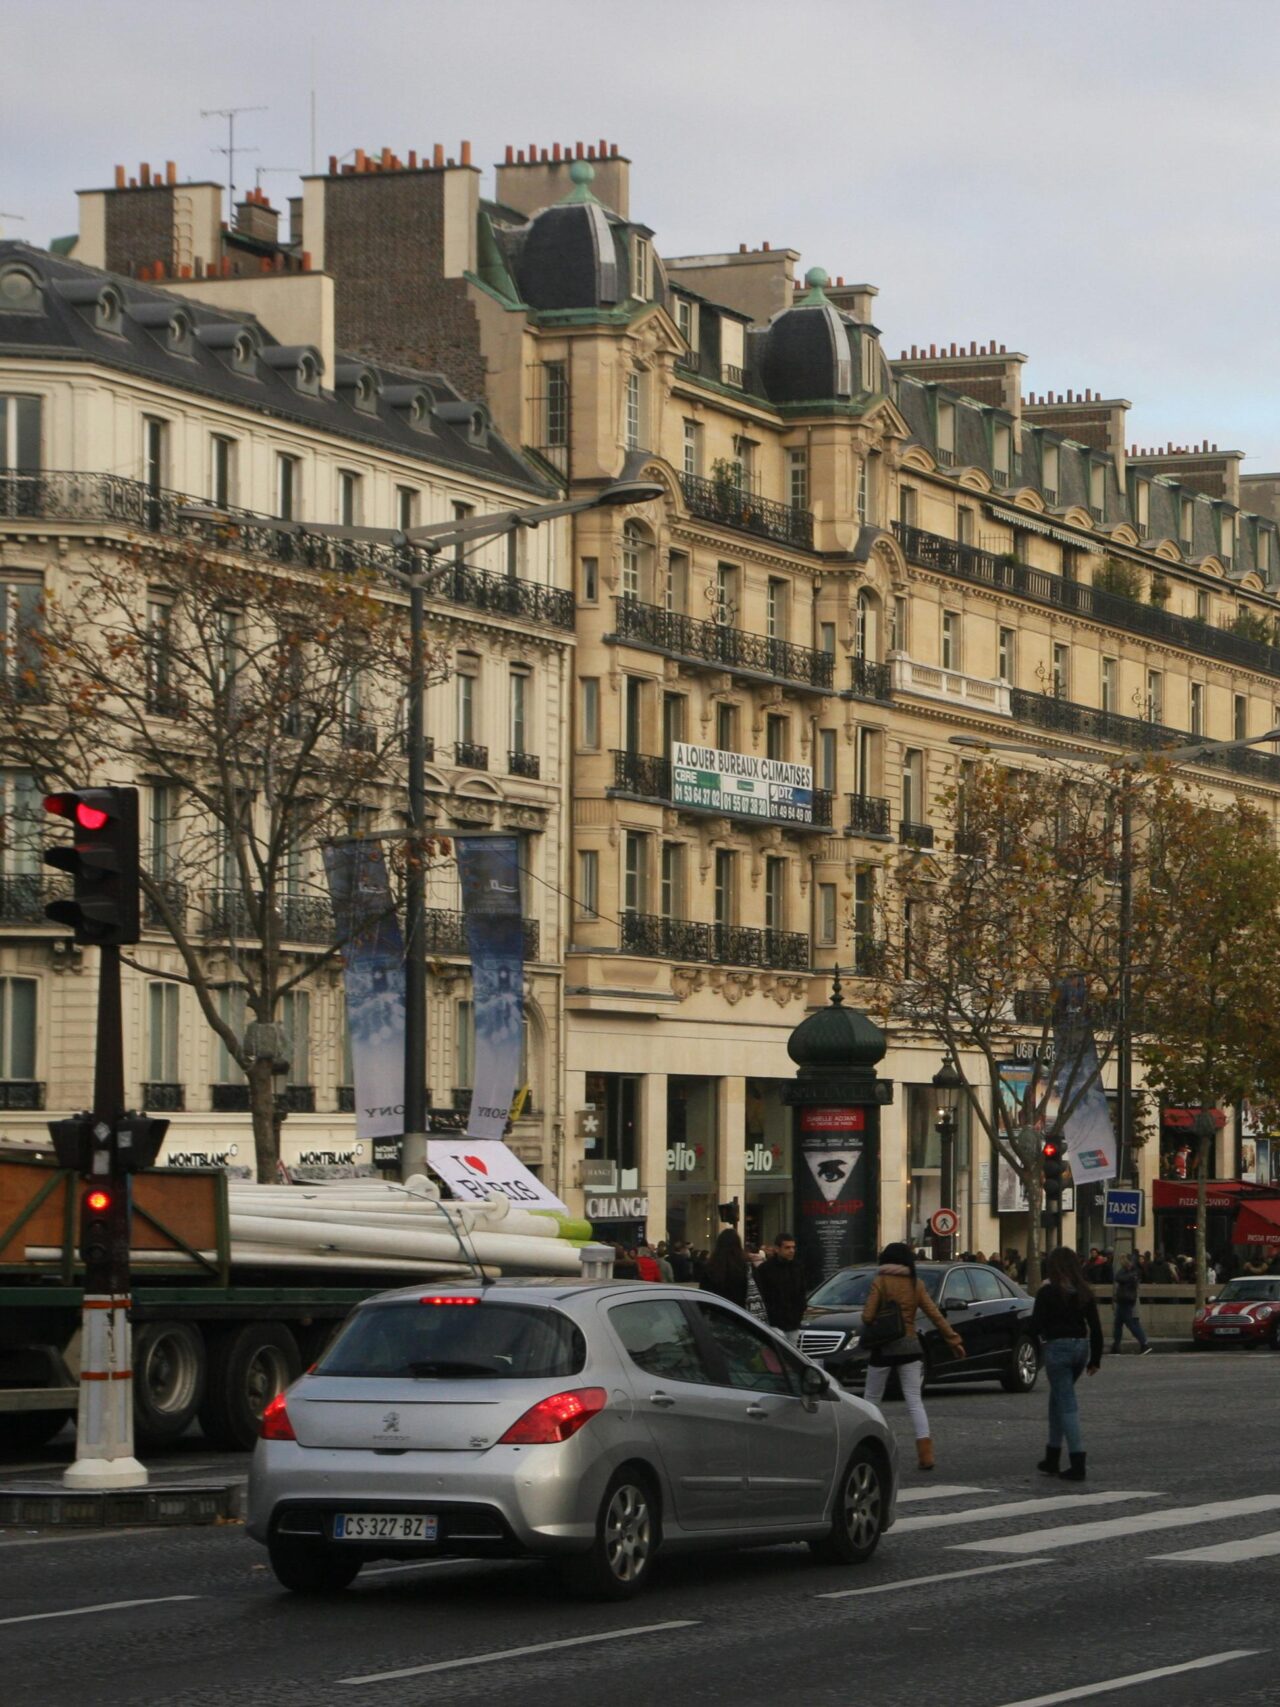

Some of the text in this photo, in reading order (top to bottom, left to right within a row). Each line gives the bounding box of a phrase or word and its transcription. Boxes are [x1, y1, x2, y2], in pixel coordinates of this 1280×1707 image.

[677, 745, 811, 788] A LOUER BUREAUX CLIMATISES
[675, 770, 697, 784] CBRE
[675, 784, 682, 801] 01
[724, 793, 731, 810] 01
[779, 786, 793, 800] DTZ
[771, 803, 778, 817] 01
[779, 805, 788, 818] 49
[797, 807, 804, 822] 49
[804, 810, 812, 824] 00
[168, 1152, 230, 1167] MONTBLANC
[300, 1151, 355, 1165] MONTBLANC
[450, 1155, 477, 1176] I
[666, 1142, 696, 1171] elio
[744, 1143, 772, 1171] elio
[456, 1180, 540, 1202] PARIS
[586, 1197, 649, 1218] CHANGE
[1108, 1202, 1137, 1214] TAXIS
[345, 1517, 423, 1537] CS-327-BZ
